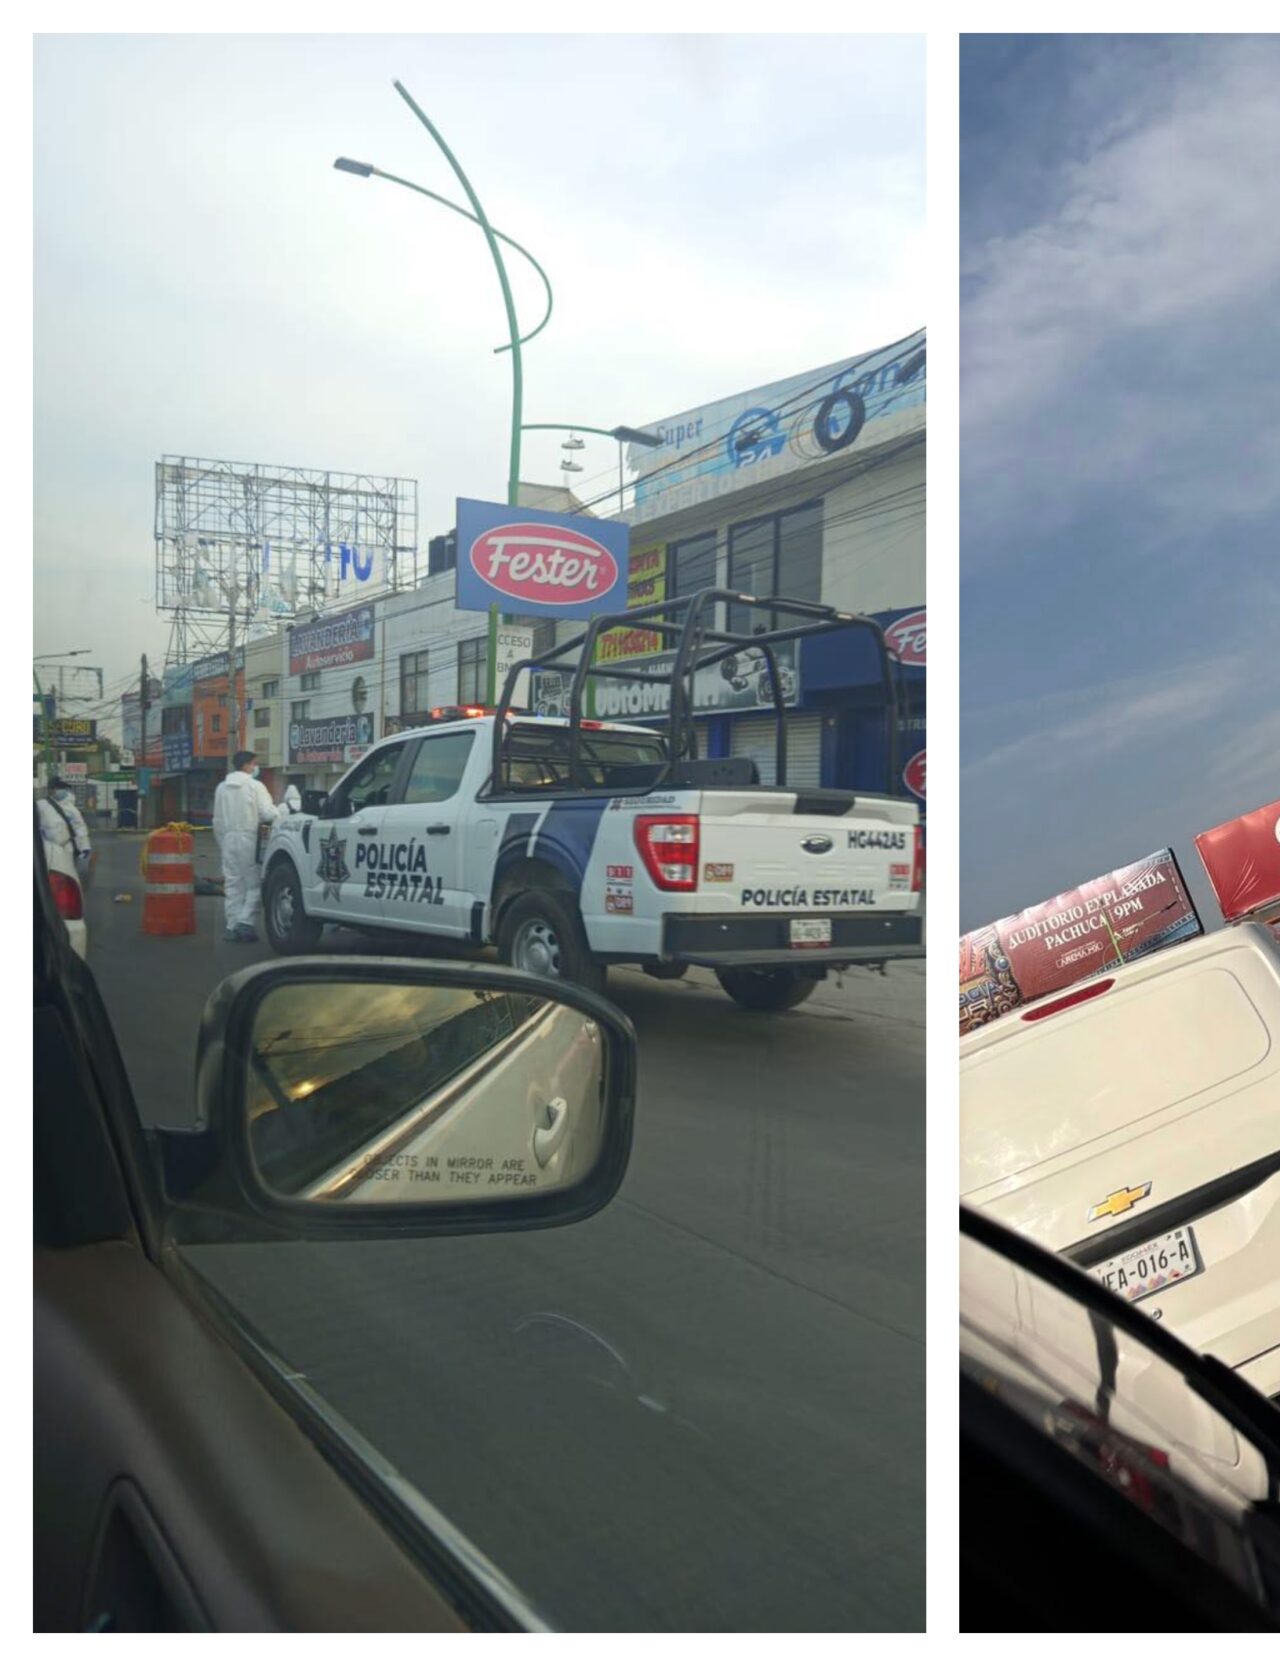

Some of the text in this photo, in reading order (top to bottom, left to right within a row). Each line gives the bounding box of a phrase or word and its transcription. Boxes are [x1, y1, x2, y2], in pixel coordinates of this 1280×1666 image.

[487, 536, 601, 590] Fester
[497, 634, 530, 648] CCESO
[355, 838, 427, 873] POLICÍA
[364, 870, 445, 905] ESTATAL
[741, 887, 876, 907] POLICÍA ESTATAL
[1008, 905, 1084, 949] AUDITORIO
[1044, 913, 1108, 950] PACHUCA
[1113, 897, 1144, 920] 9PM
[409, 1170, 440, 1182] THAN
[450, 1171, 480, 1184] THEY
[488, 1172, 537, 1186] APPEAR
[426, 1157, 438, 1168] IN
[447, 1158, 493, 1170] MIRROR
[502, 1160, 525, 1171] ARE
[1102, 1240, 1190, 1292] EA-016-A
